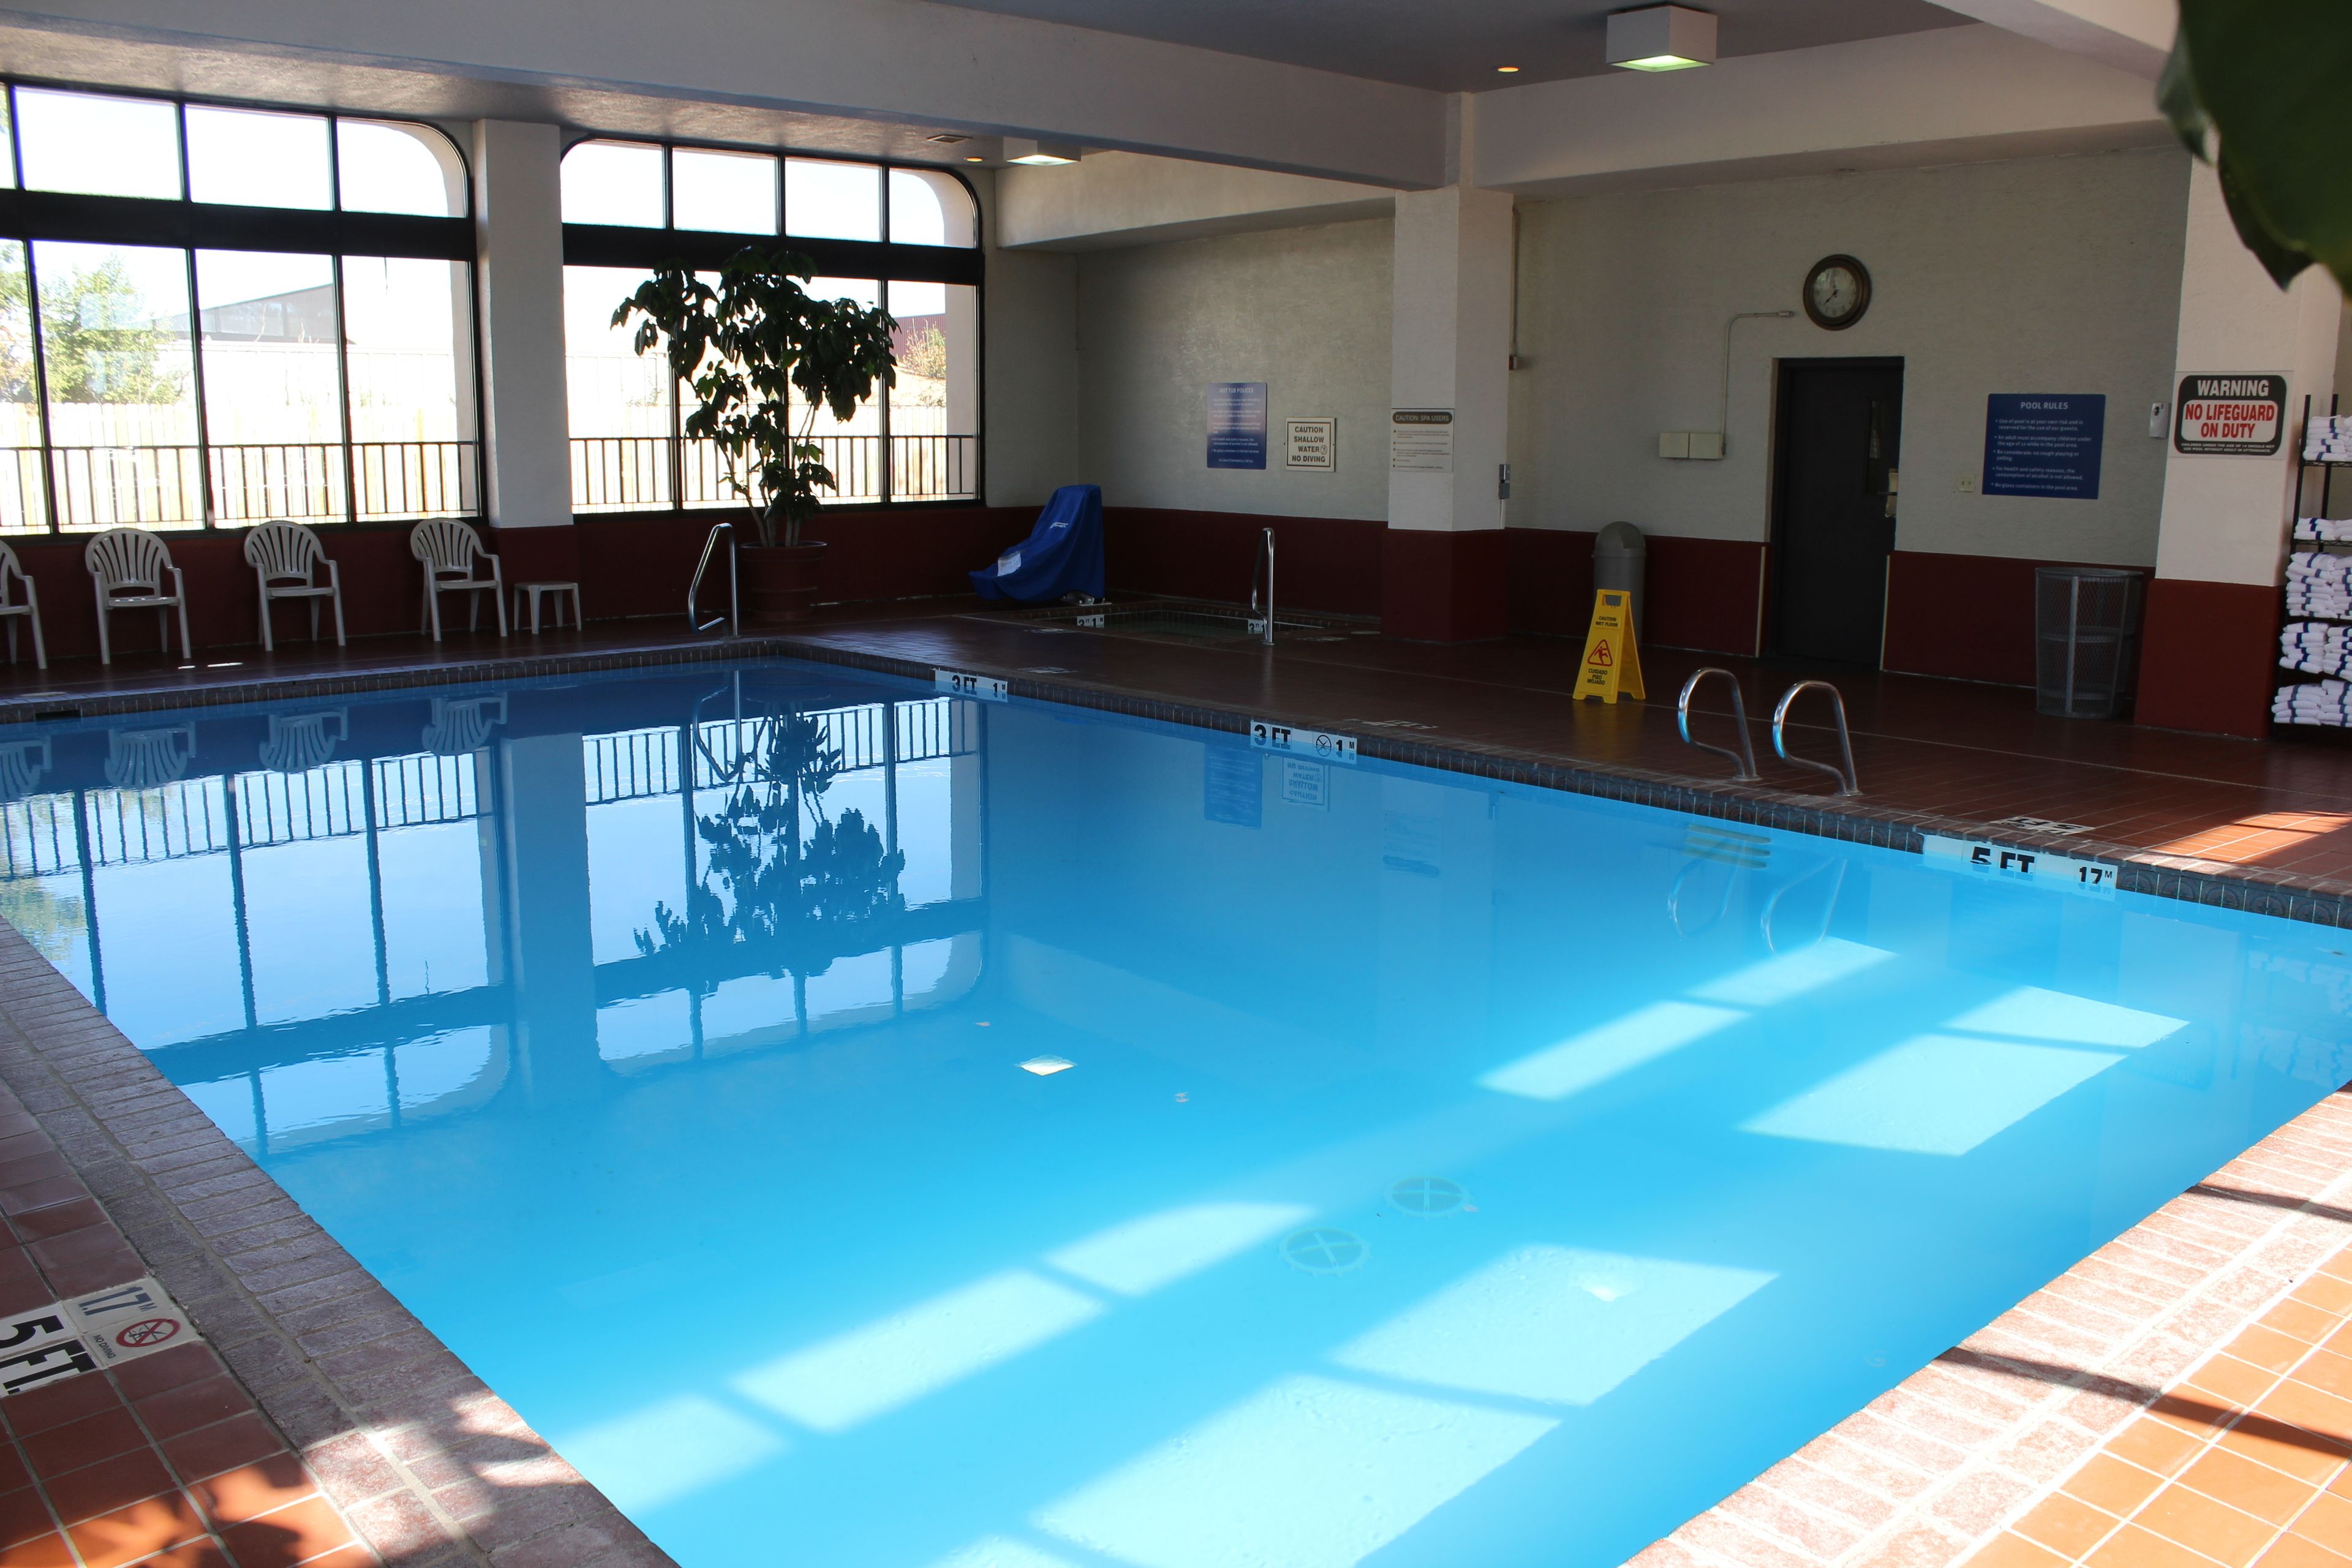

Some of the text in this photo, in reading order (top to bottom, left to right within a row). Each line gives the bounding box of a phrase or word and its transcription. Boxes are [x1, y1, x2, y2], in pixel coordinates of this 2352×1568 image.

[2197, 380, 2269, 397] WARNING
[2185, 404, 2275, 421] NO LIFEGUARD
[2201, 423, 2256, 439] ON DUTY
[1092, 617, 1096, 628] 1
[952, 674, 960, 685] 3
[963, 676, 977, 687] FT
[993, 682, 998, 692] 1
[1254, 724, 1267, 737] 3
[1272, 727, 1291, 742] FT
[1336, 739, 1343, 751] 1
[1970, 846, 1992, 865] 5
[0, 1315, 64, 1348] 5
[93, 1335, 116, 1359] NO DIVING
